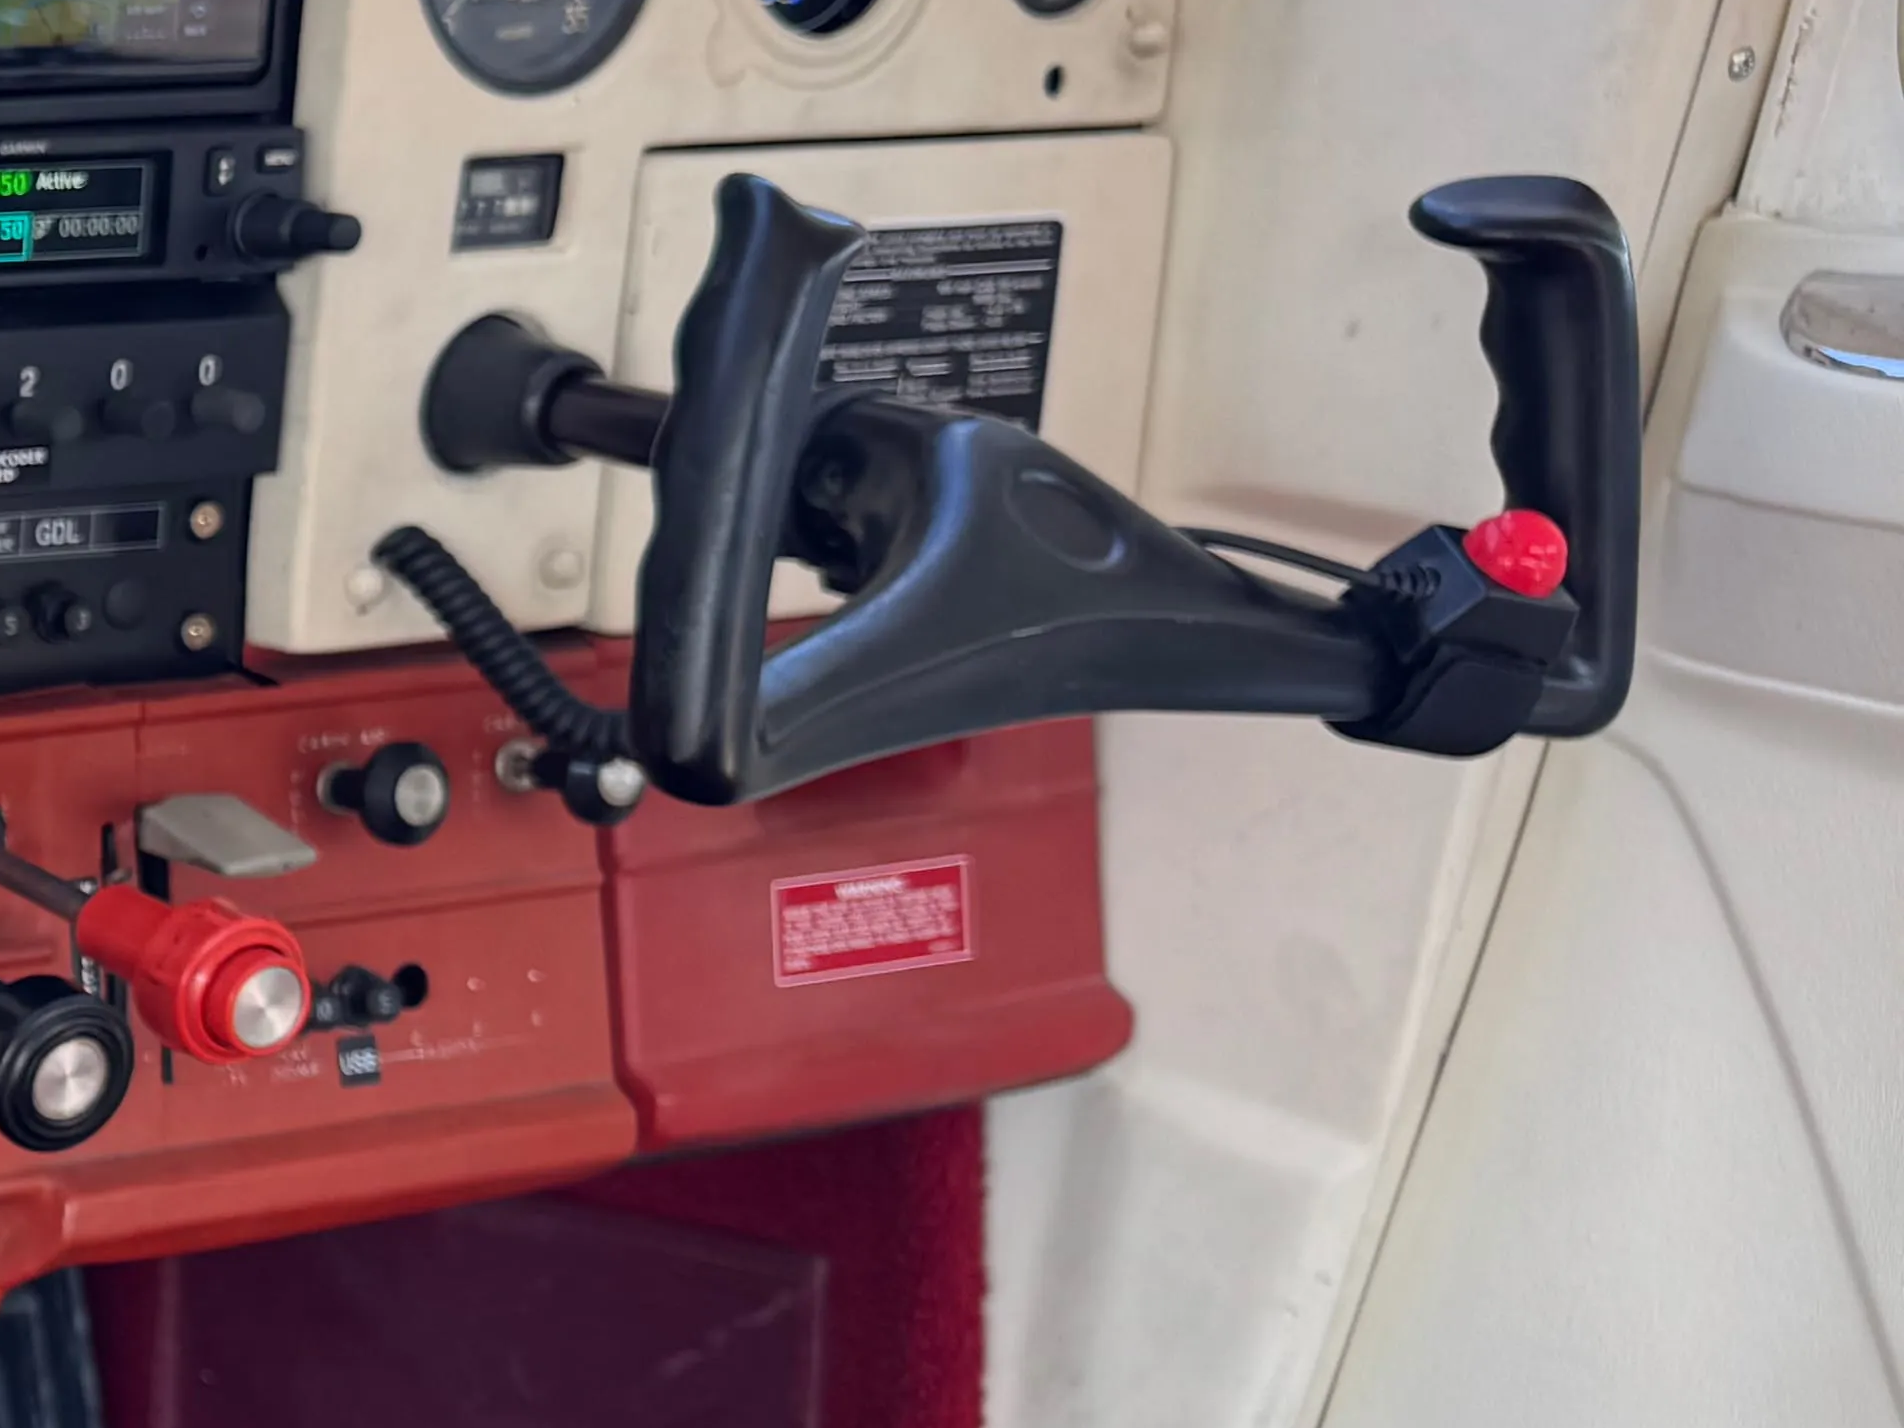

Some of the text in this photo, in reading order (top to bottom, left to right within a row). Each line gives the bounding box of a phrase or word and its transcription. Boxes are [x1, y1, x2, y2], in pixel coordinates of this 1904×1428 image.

[36, 172, 89, 191] Active
[59, 214, 139, 239] 00:00:00
[19, 366, 41, 398] 2
[110, 359, 131, 391] 0
[198, 355, 220, 386] 0
[35, 518, 81, 547] GDL
[338, 1047, 380, 1076] USB
